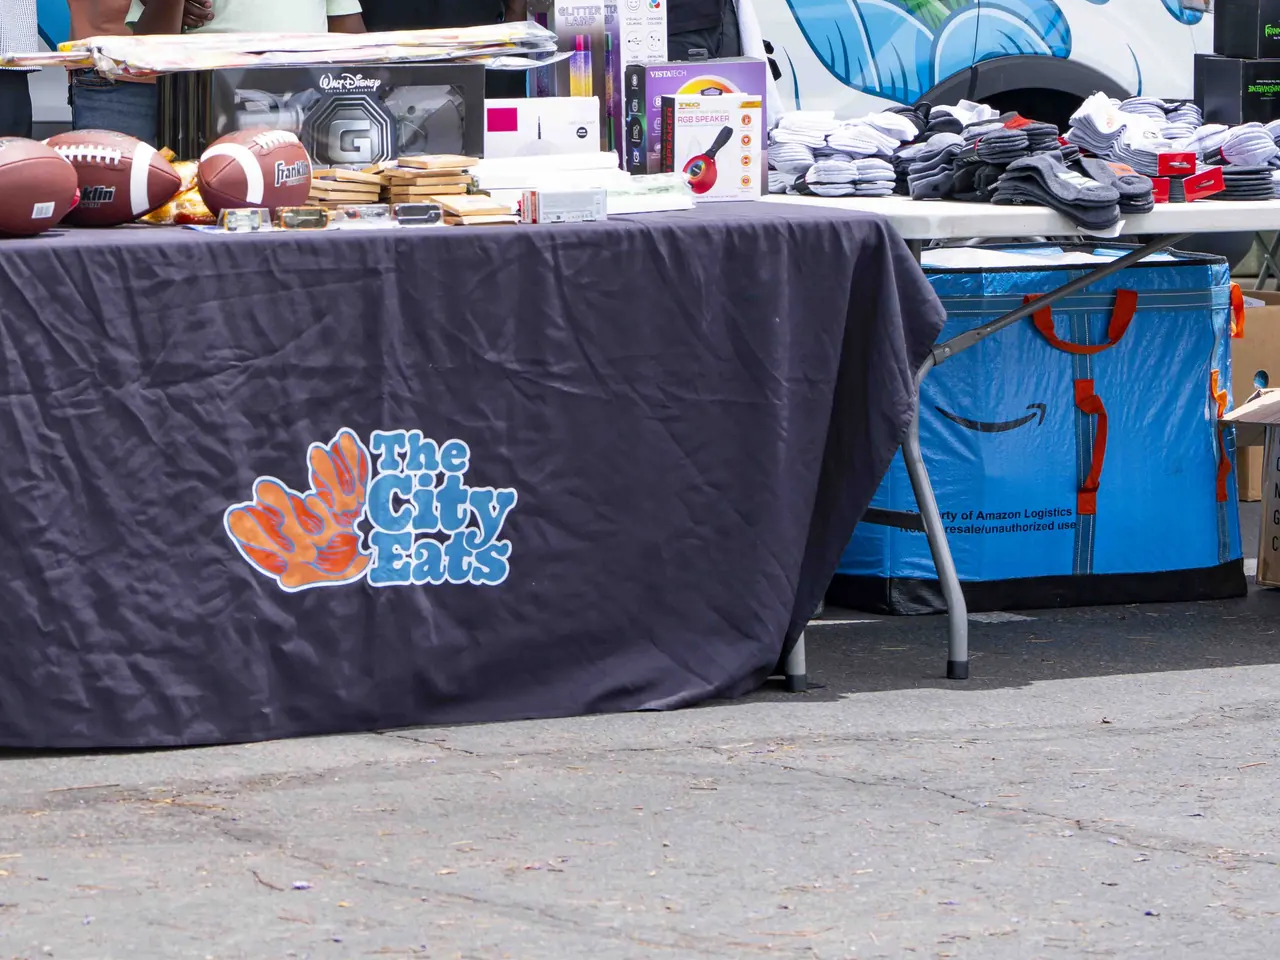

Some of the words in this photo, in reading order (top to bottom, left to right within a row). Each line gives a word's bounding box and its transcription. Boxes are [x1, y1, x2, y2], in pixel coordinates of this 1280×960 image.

[558, 6, 602, 18] GLITTER
[565, 16, 596, 27] LAMP
[650, 69, 687, 78] VISTATECH
[677, 115, 694, 124] RGB
[695, 115, 730, 123] SPEAKER
[327, 119, 372, 163] G
[275, 160, 309, 187] Franklin
[81, 185, 116, 202] klin
[371, 431, 468, 472] The
[368, 473, 517, 551] City
[961, 510, 974, 520] of
[976, 510, 1021, 520] Amazon
[1024, 507, 1073, 520] Logistics
[945, 521, 1055, 535] resale/unauthorized
[1057, 521, 1077, 530] use
[369, 530, 511, 584] Eats
